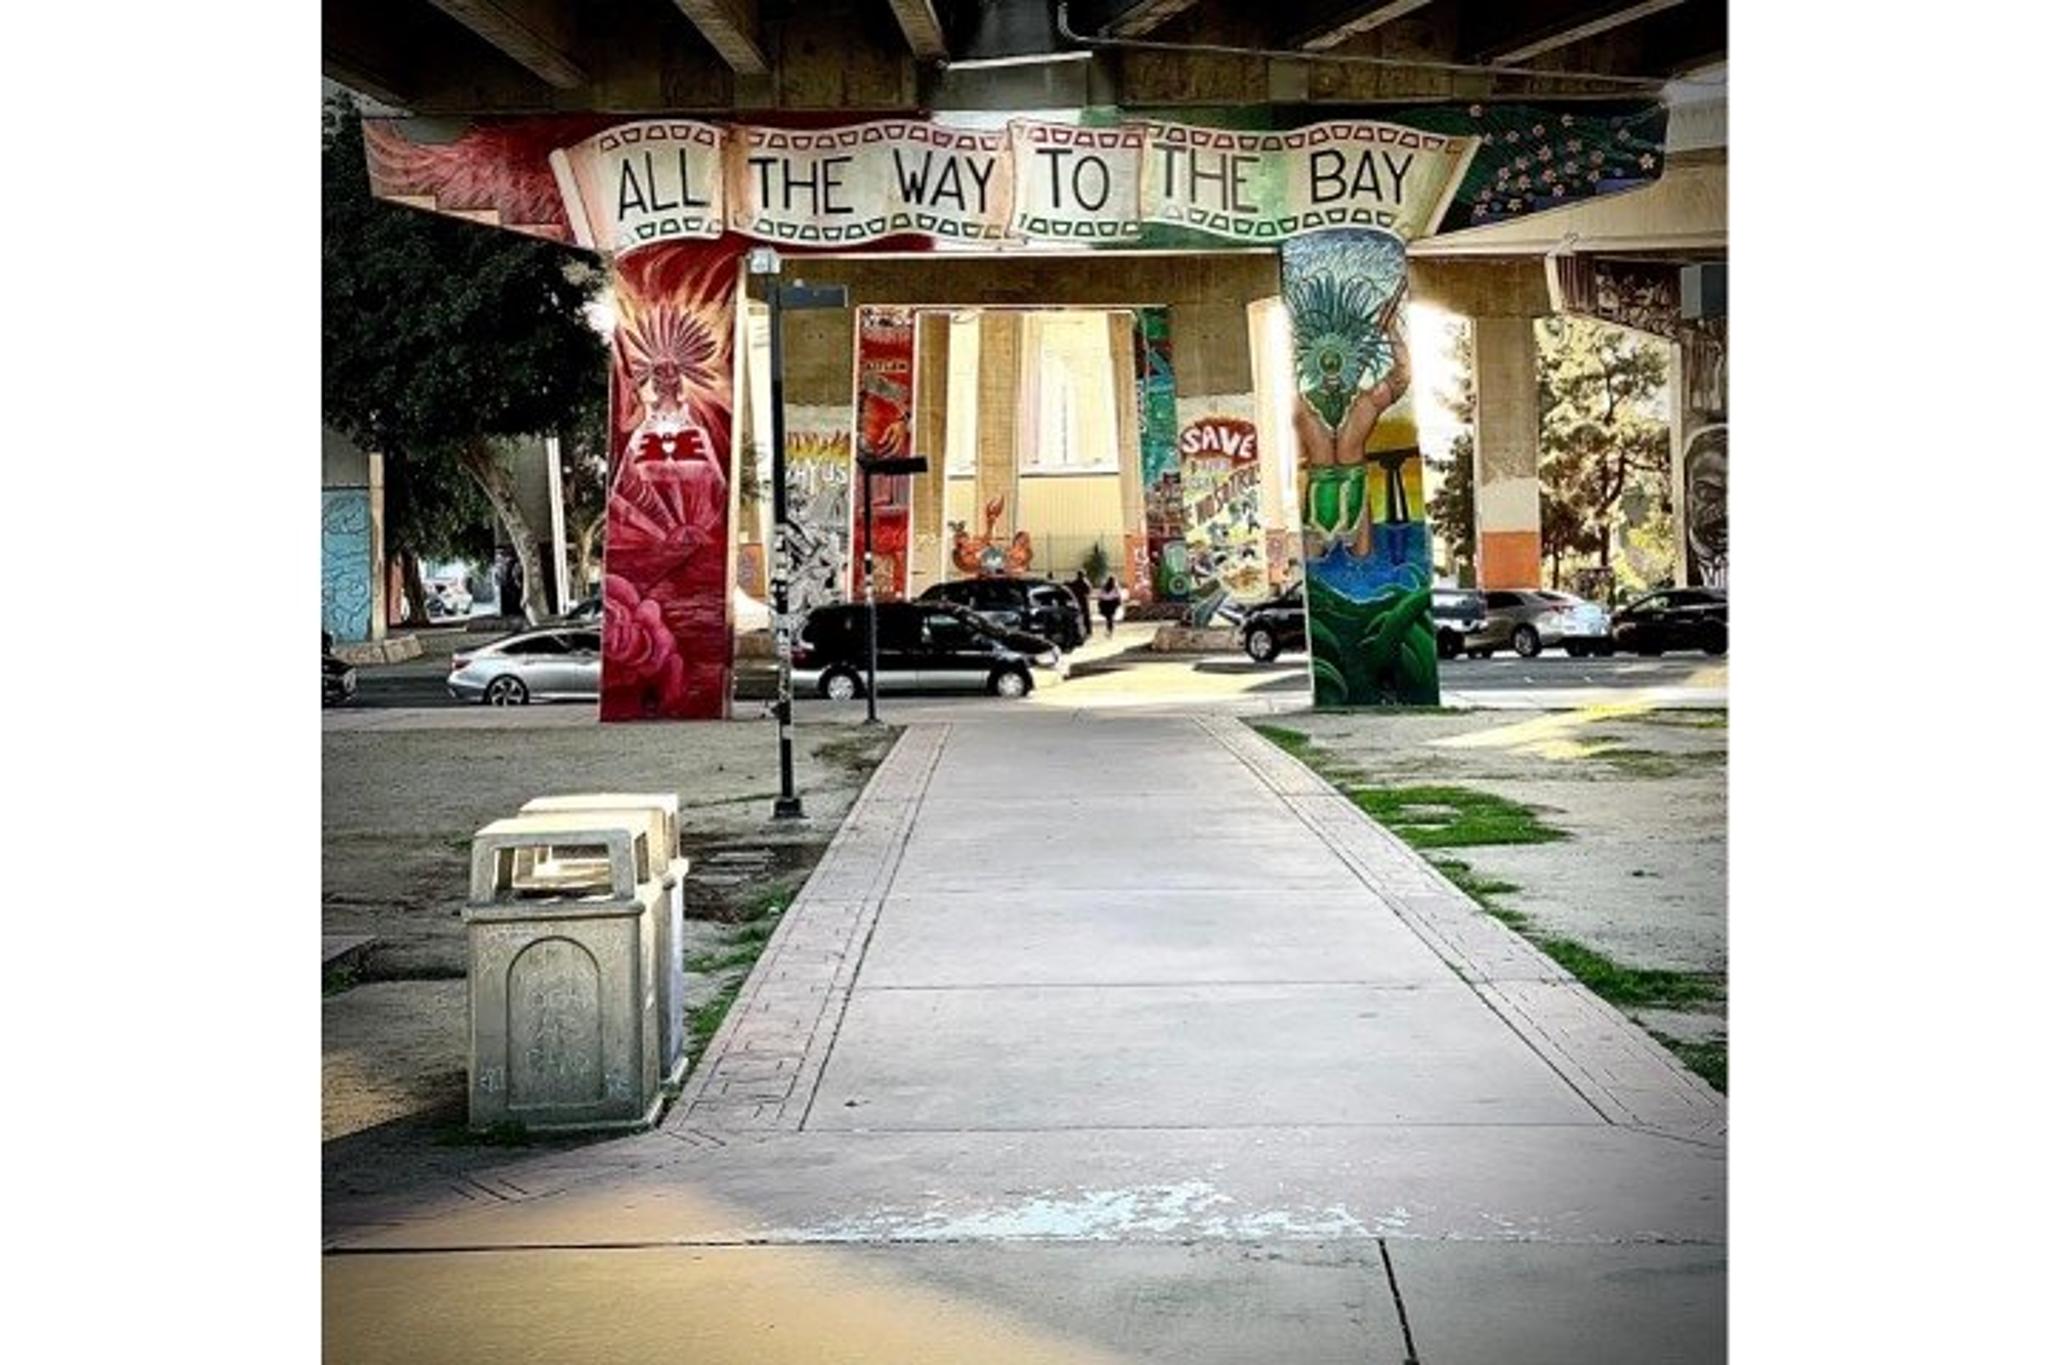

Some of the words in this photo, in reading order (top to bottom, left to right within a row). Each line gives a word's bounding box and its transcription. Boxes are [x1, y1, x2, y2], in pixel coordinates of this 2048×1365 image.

[617, 147, 711, 221] ALL
[747, 156, 854, 216] THE
[893, 148, 995, 213] WAY
[1035, 147, 1111, 211] TO
[1151, 142, 1260, 214] THE
[1308, 149, 1414, 206] BAY
[1182, 426, 1254, 458] SAVE
